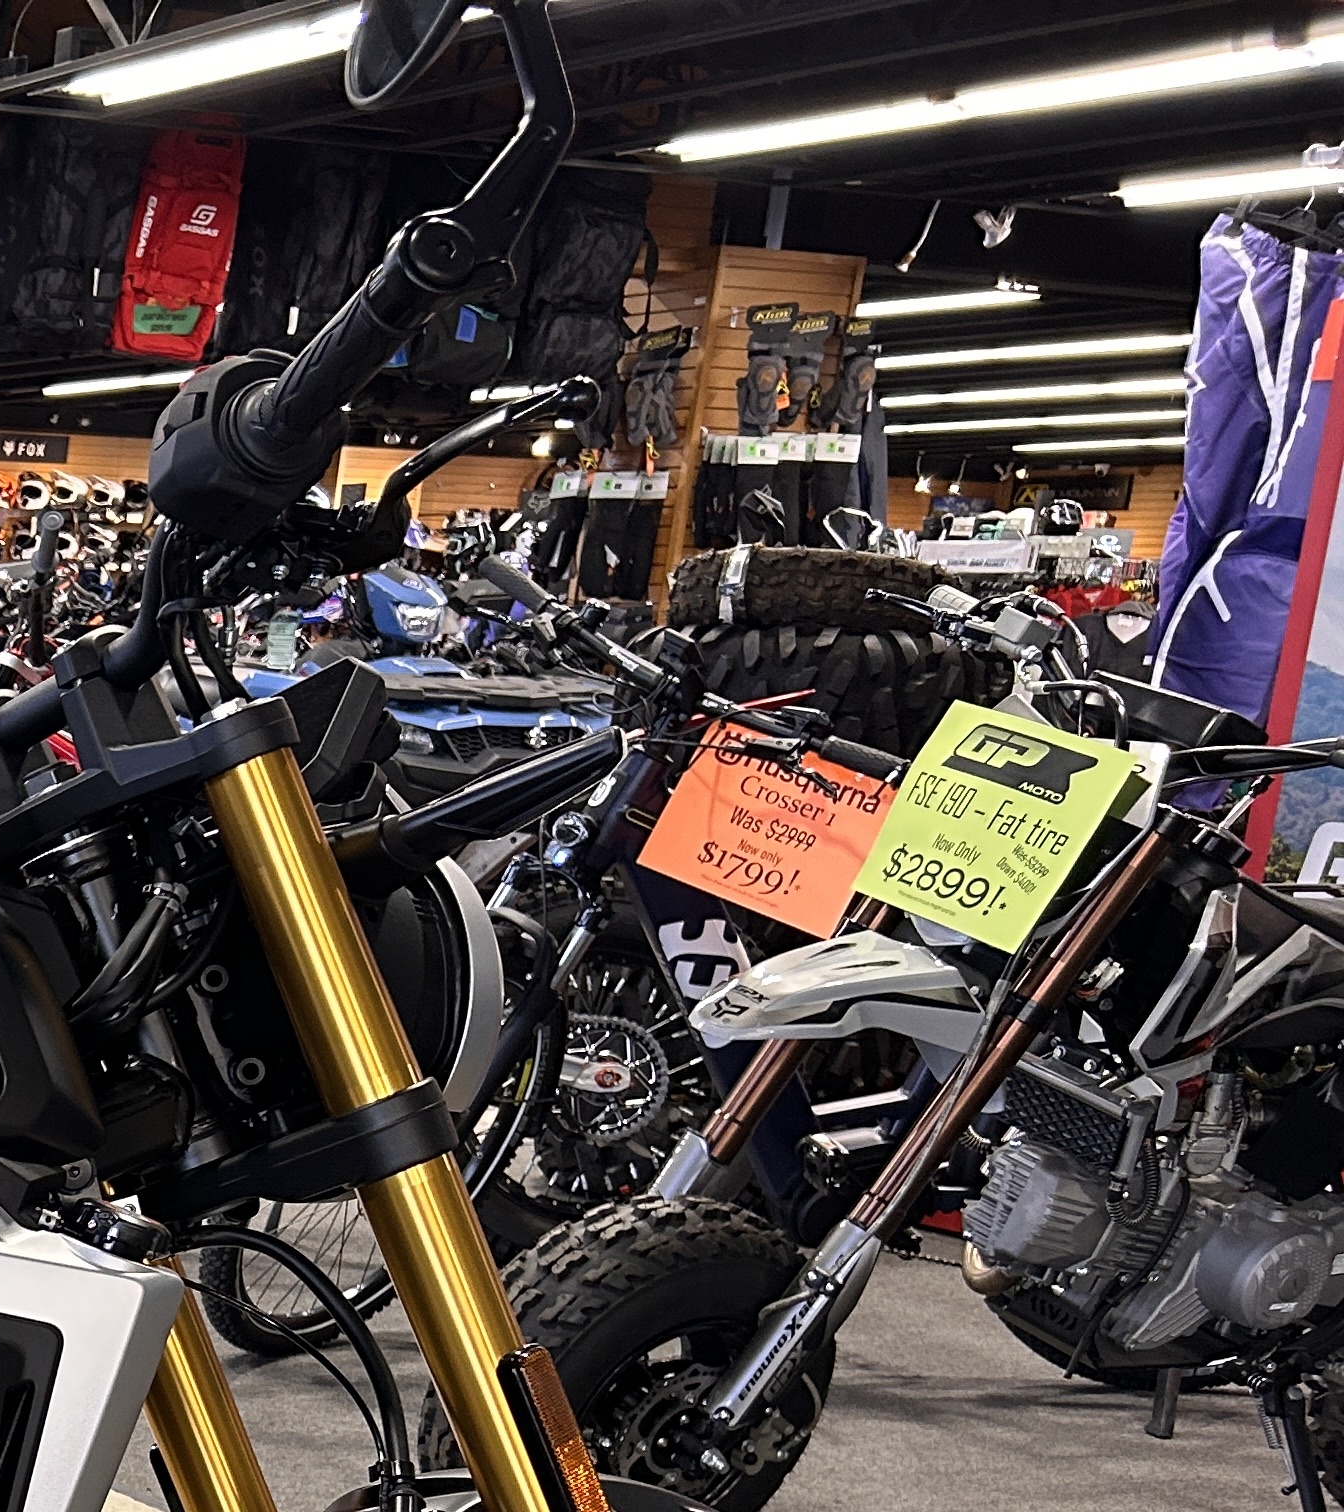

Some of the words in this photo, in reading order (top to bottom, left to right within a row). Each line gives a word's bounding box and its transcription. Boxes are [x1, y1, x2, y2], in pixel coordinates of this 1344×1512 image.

[135, 195, 158, 258] GASGAS
[179, 223, 219, 238] GASGAS
[752, 307, 793, 323] Klim
[16, 442, 47, 457] FOX
[739, 775, 825, 822] Crosser
[1018, 781, 1064, 803] MOTO
[729, 805, 763, 833] Was
[765, 818, 817, 852] $2999
[906, 771, 947, 809] FSE
[937, 783, 978, 819] 190
[986, 799, 1027, 839] Fat
[1024, 819, 1070, 856] tire
[737, 839, 760, 857] Now
[760, 846, 784, 867] only
[932, 833, 954, 852] Now
[954, 839, 982, 867] Only
